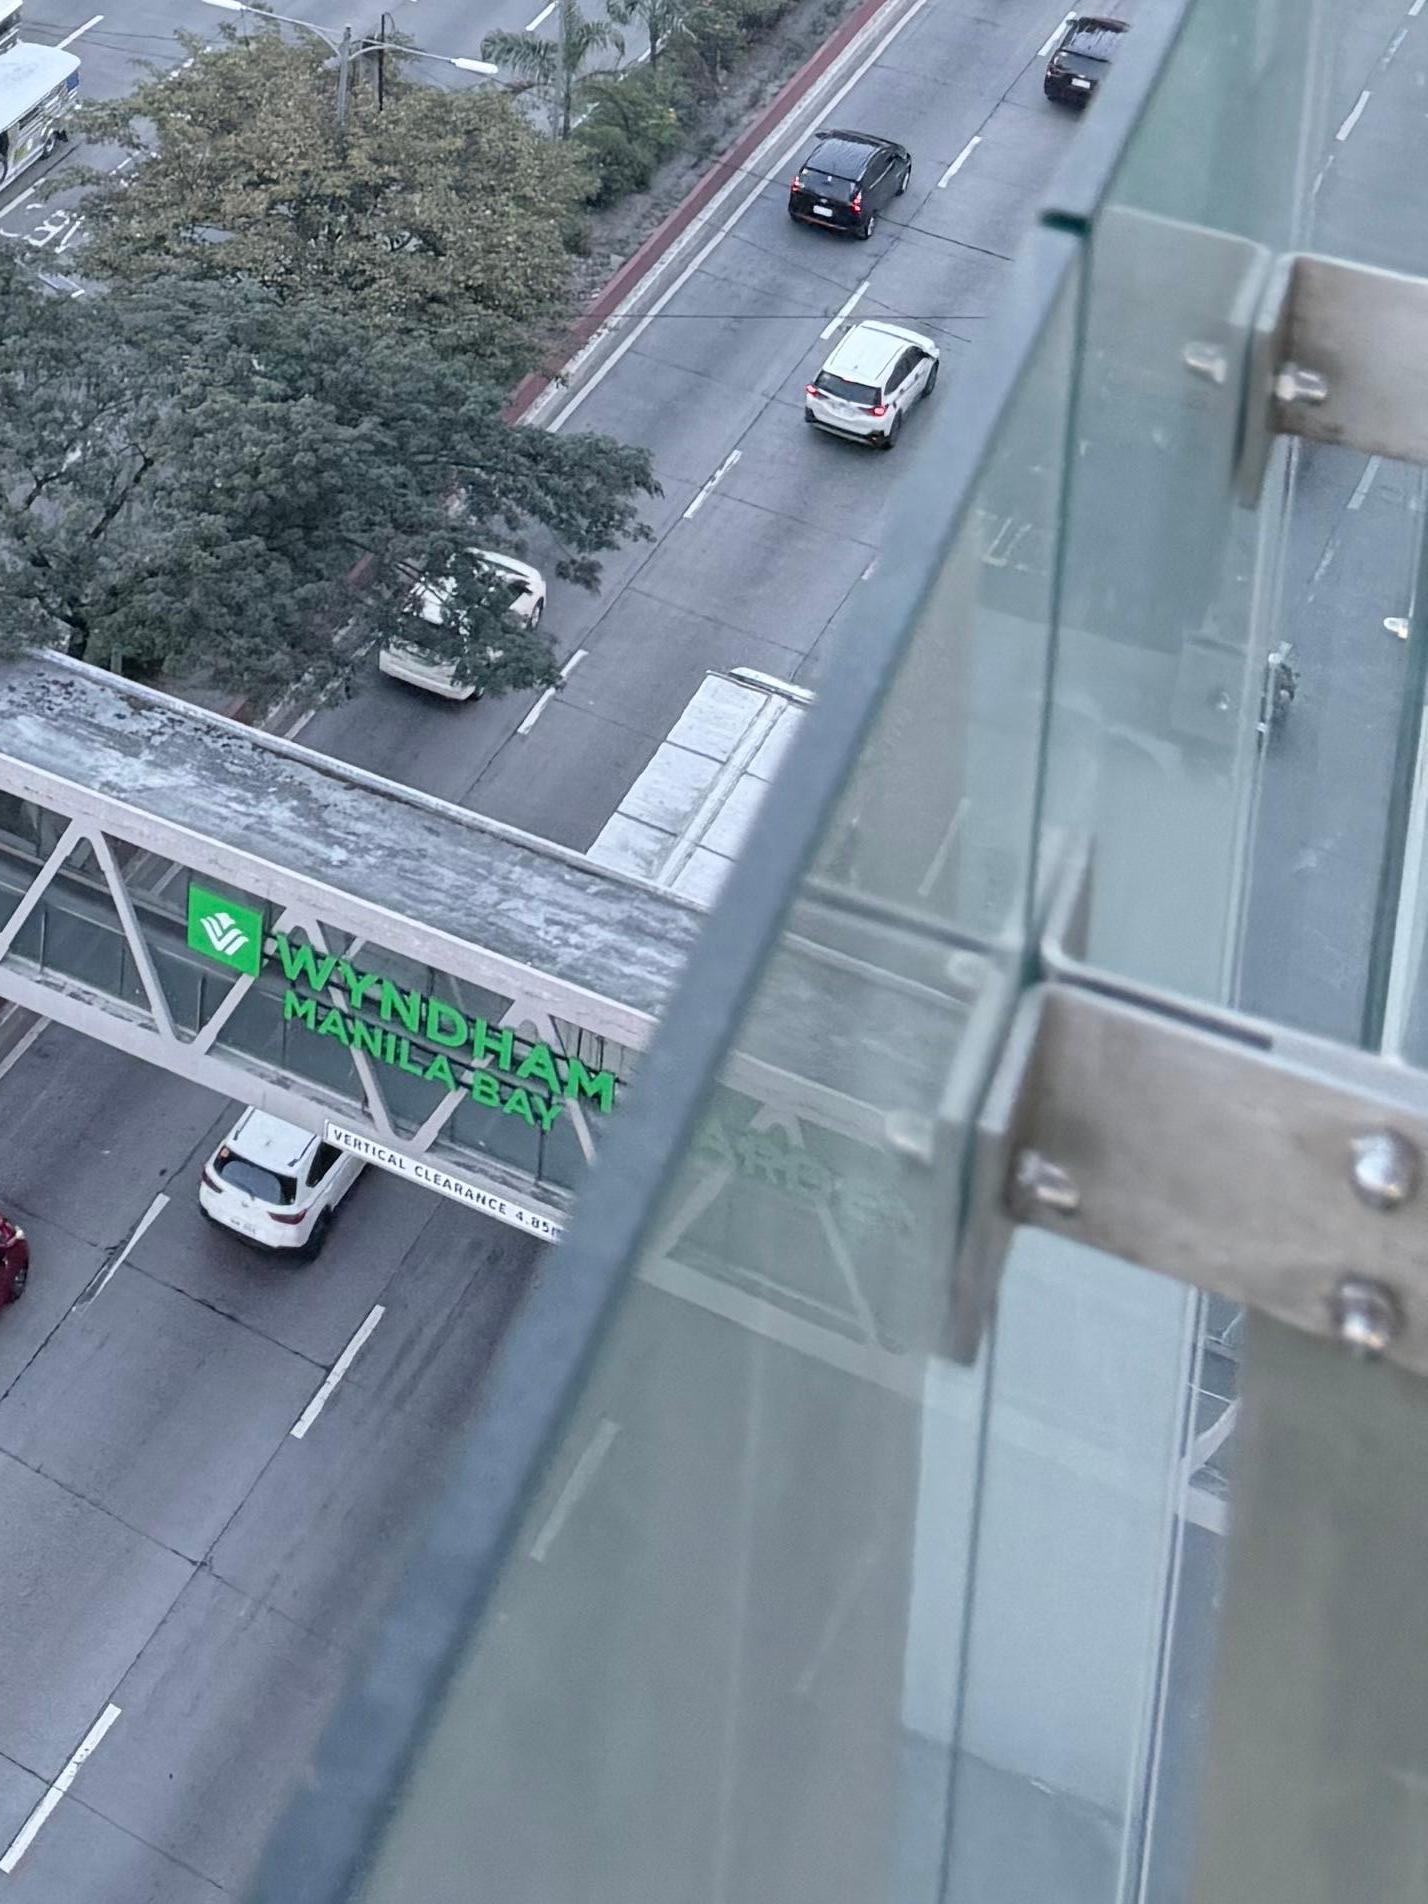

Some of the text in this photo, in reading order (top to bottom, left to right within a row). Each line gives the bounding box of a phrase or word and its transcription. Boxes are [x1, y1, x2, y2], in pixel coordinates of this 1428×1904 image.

[276, 932, 616, 1115] WYNDHAM
[283, 991, 563, 1132] MANILA BAY
[333, 1128, 407, 1171] VERTICAL
[413, 1164, 508, 1215] CLEARANCE
